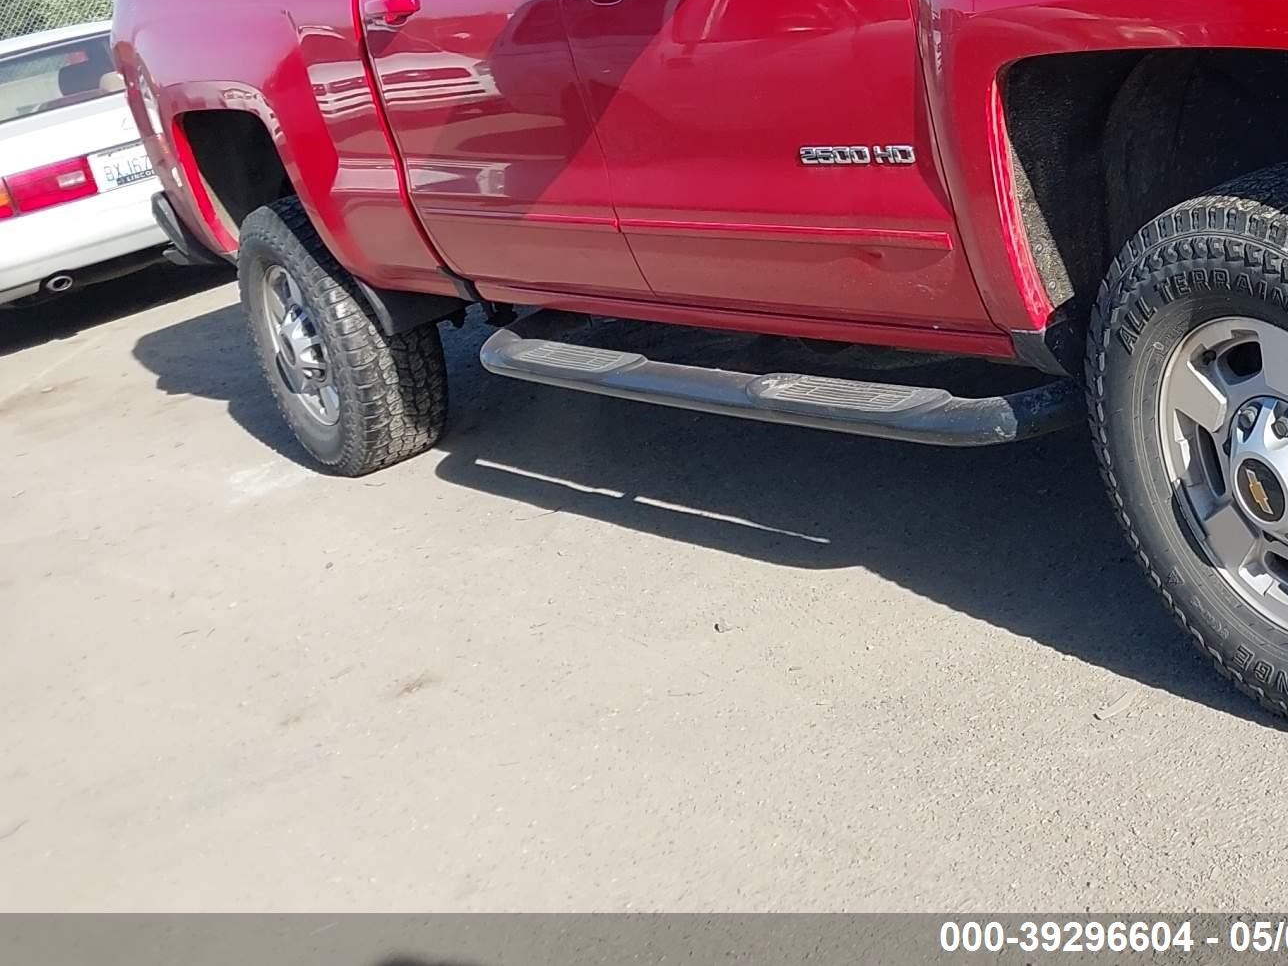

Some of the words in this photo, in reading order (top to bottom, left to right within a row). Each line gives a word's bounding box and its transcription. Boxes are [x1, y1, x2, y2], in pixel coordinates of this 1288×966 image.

[799, 145, 871, 165] 2500
[873, 145, 916, 165] HD
[1118, 296, 1159, 356] ALL
